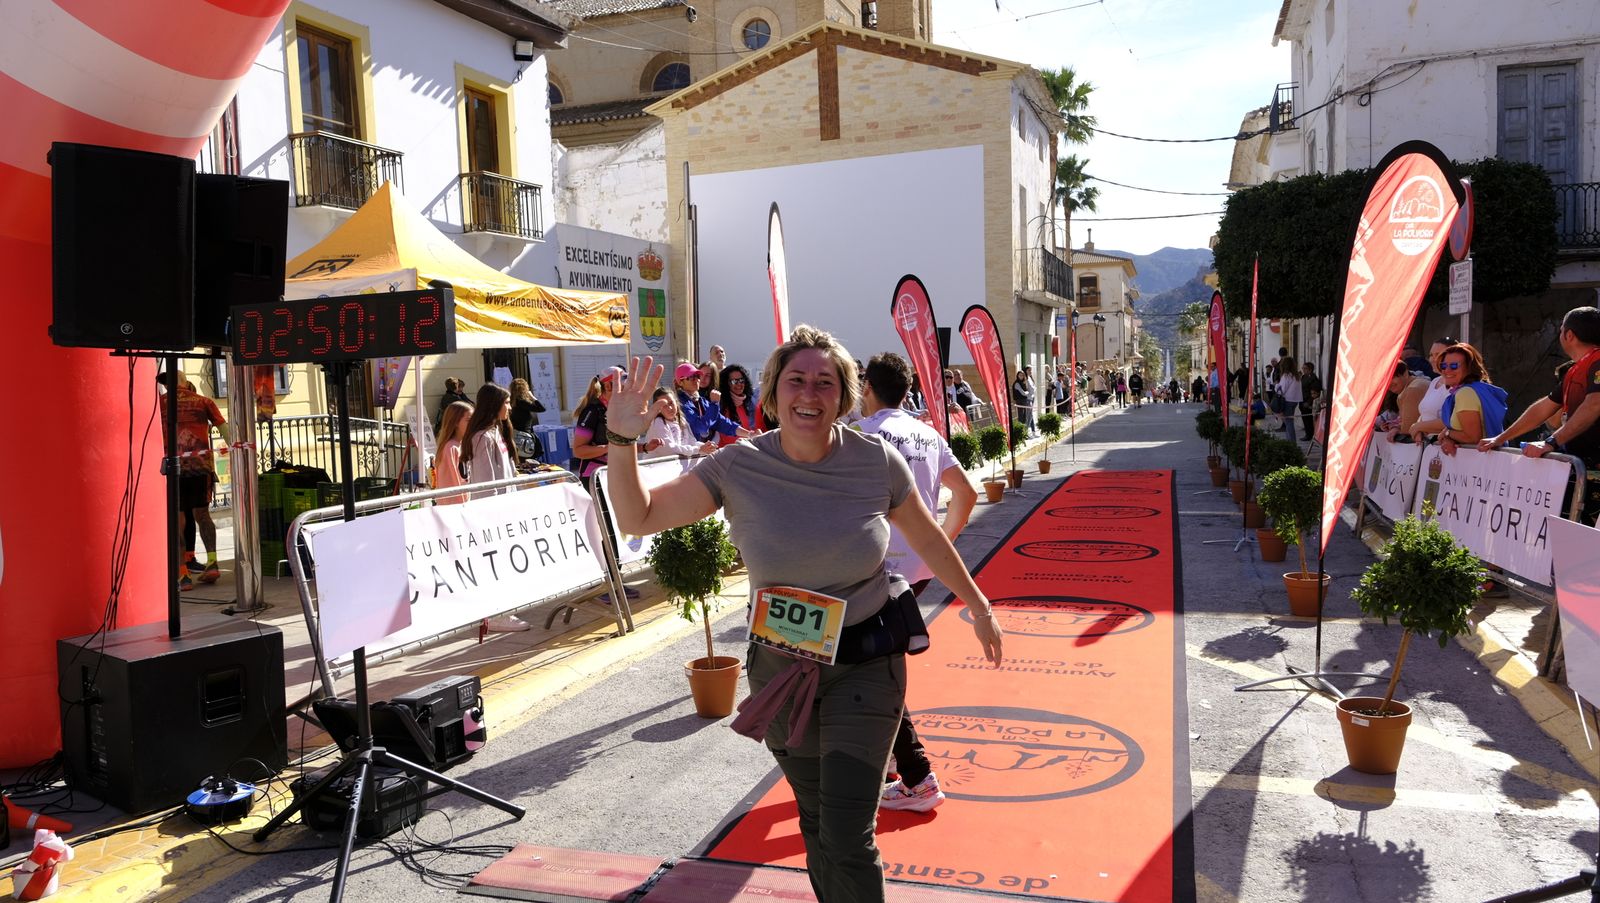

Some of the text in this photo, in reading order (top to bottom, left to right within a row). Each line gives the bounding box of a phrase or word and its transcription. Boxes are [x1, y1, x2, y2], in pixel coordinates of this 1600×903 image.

[565, 246, 633, 271] EXCELENTÍSIMO
[569, 271, 633, 293] AYUNTAMIENTO
[1534, 490, 1551, 509] DE
[405, 508, 577, 561] YUNTAMIENTO DE
[769, 597, 824, 631] 501
[1065, 730, 1106, 741] LA
[349, 776, 364, 811] VONYX
[998, 875, 1050, 893] de
